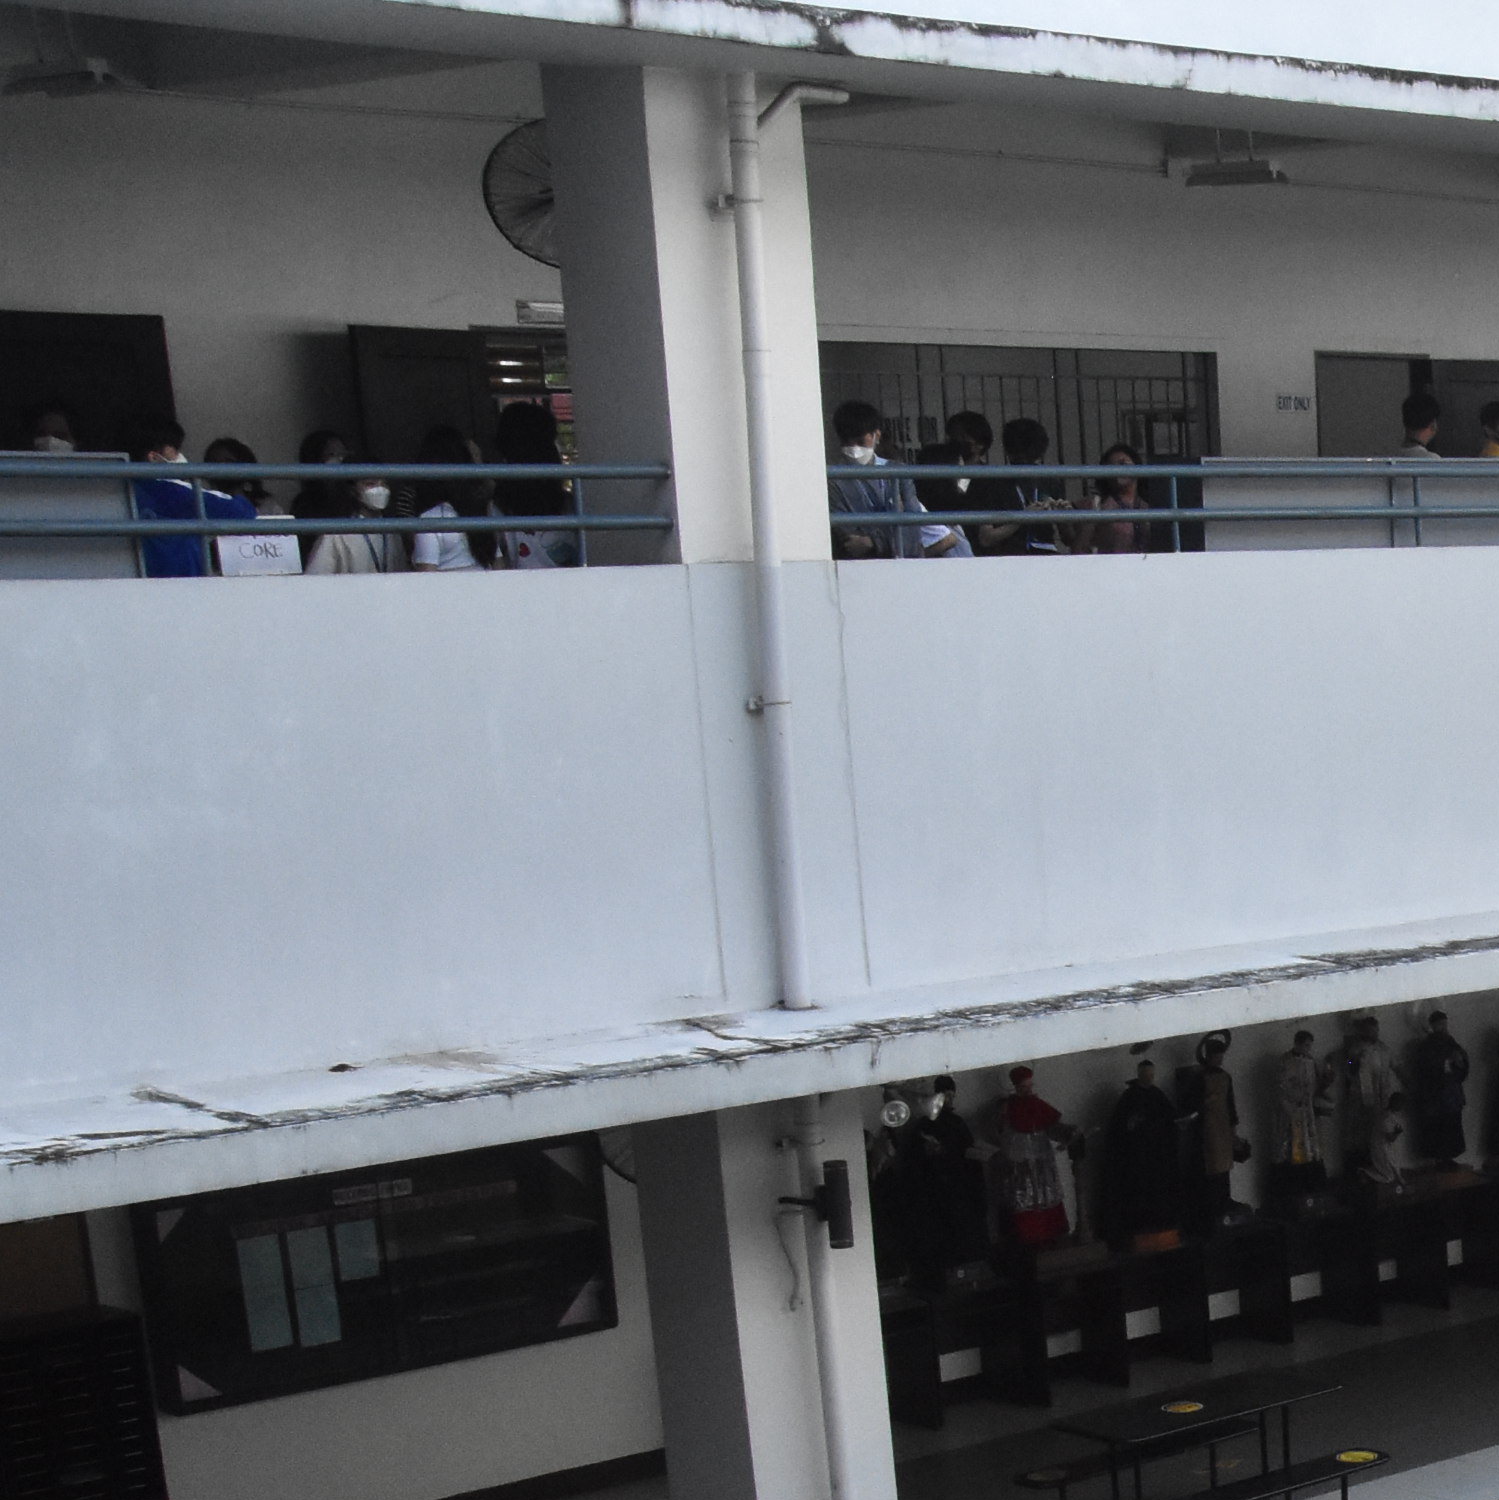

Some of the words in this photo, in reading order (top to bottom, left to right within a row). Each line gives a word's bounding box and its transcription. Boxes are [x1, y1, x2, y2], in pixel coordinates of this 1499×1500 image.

[1278, 395, 1292, 410] EXIT
[1294, 396, 1312, 411] ONLY
[238, 542, 284, 559] CORE
